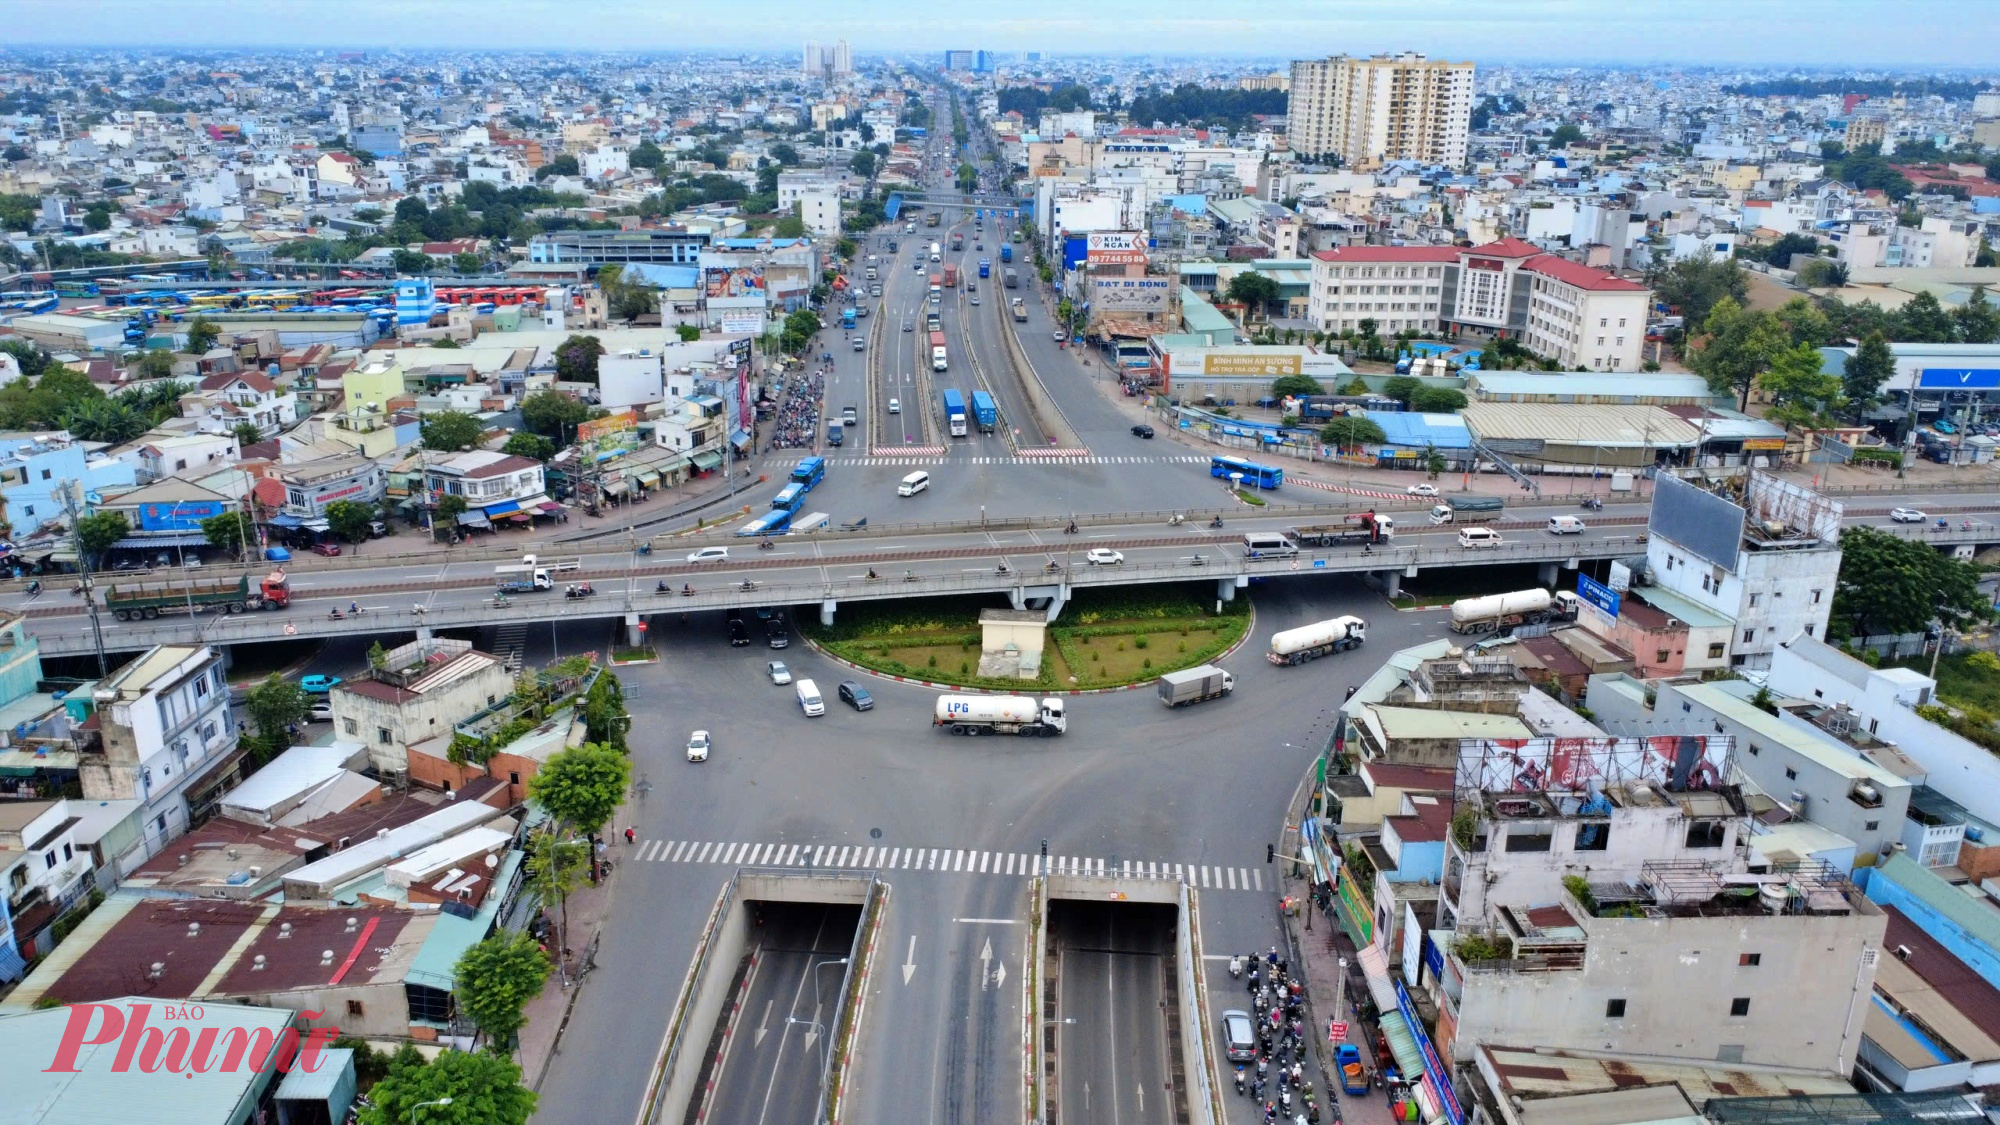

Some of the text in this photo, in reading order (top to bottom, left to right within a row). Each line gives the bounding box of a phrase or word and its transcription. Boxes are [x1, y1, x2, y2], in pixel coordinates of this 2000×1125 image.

[1213, 356, 1232, 365] BÌNH
[1232, 357, 1251, 365] MINH
[1254, 357, 1265, 365] AN
[1588, 583, 1614, 603] PINACO
[947, 702, 969, 713] LPG
